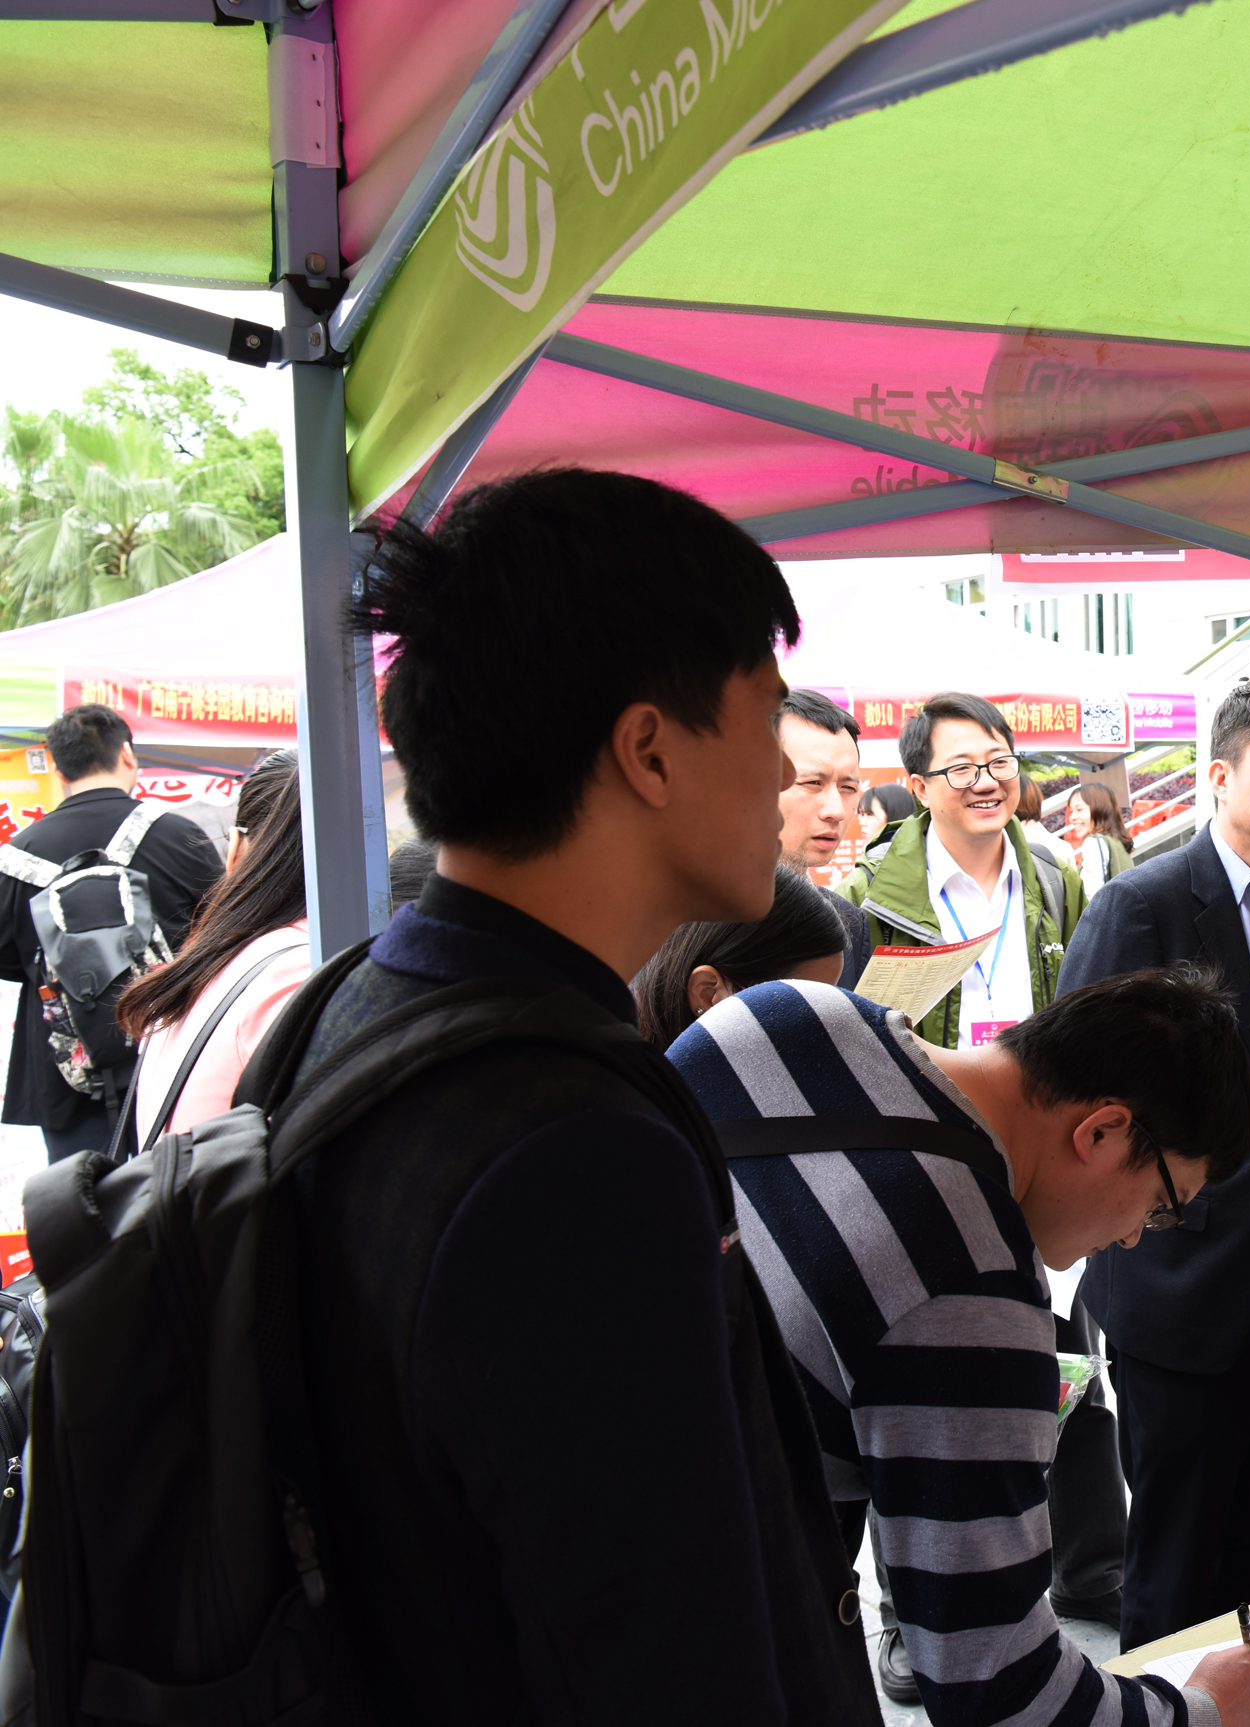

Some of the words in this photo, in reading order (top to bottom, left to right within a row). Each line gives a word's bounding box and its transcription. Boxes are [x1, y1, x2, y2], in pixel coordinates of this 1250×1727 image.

[580, 46, 700, 197] China
[137, 680, 298, 724] 广西南宁桃李园教育咨询有
